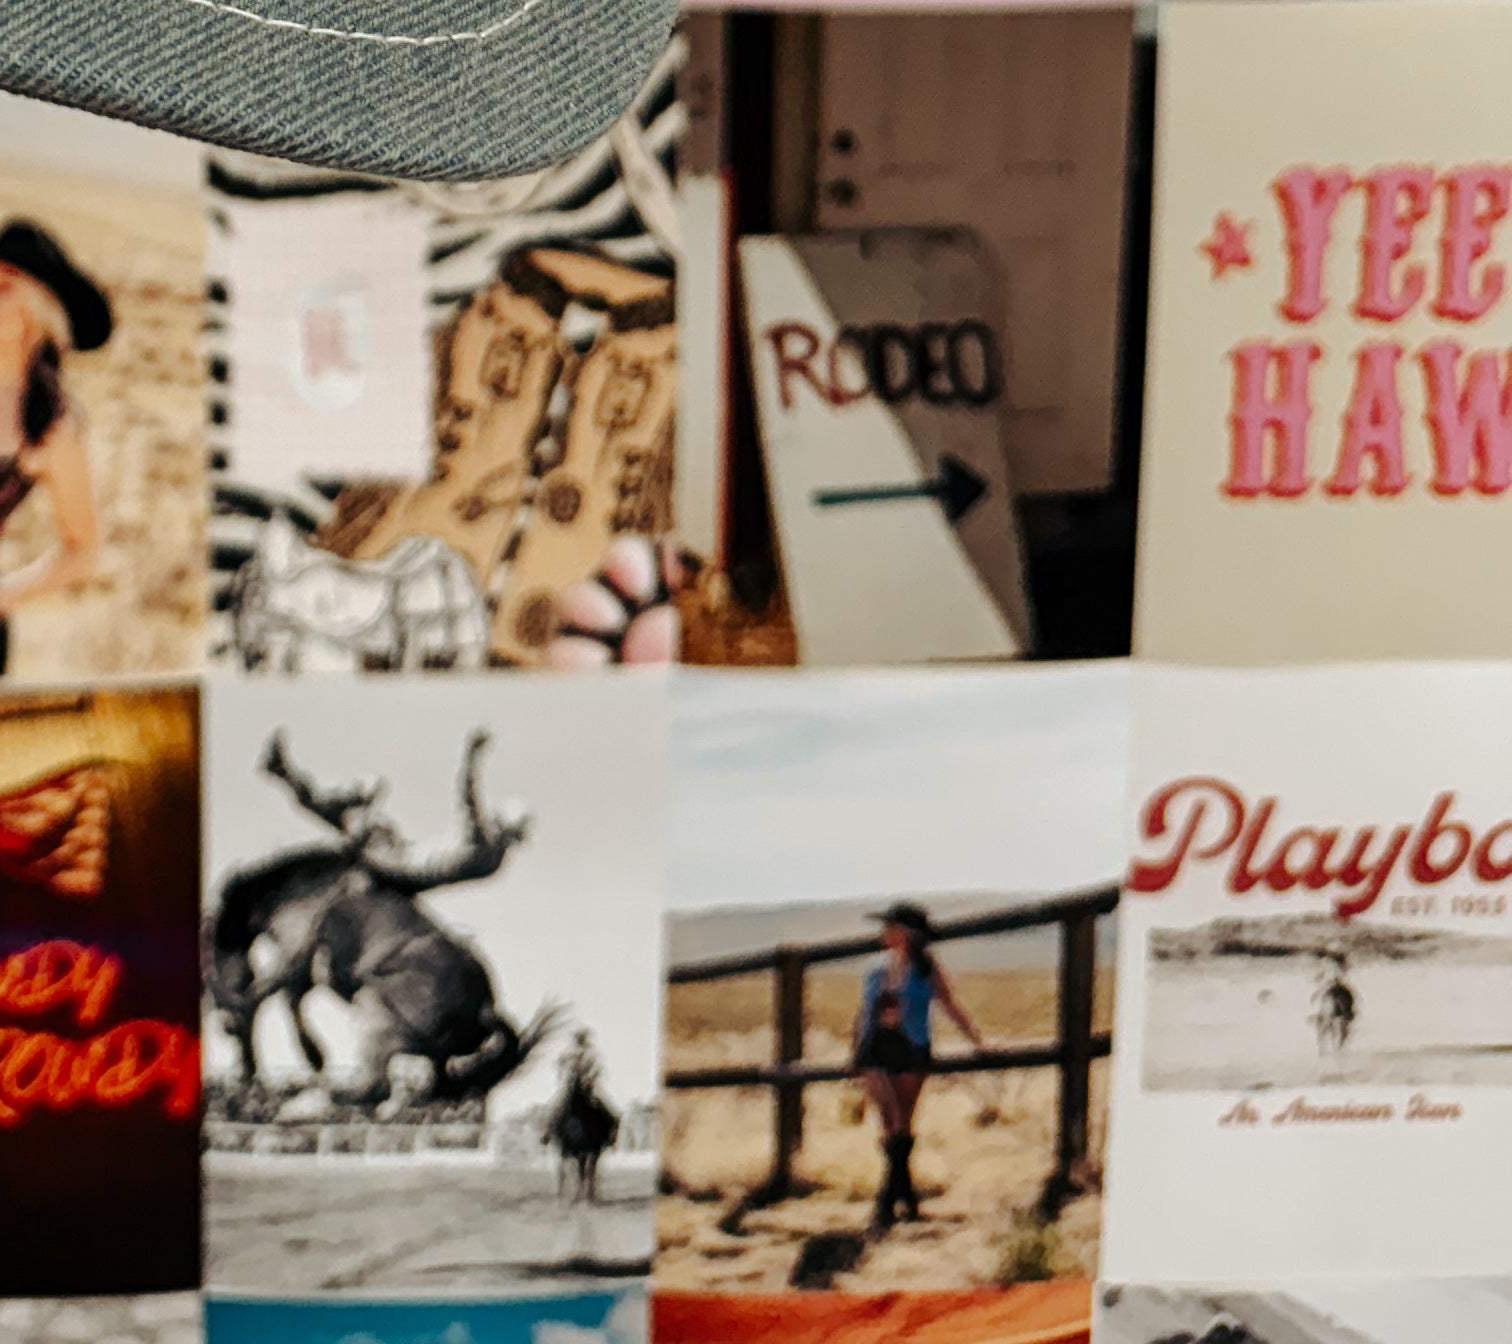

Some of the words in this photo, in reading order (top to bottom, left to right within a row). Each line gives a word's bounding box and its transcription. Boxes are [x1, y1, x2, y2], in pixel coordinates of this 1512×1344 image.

[1271, 164, 1512, 323] YEE
[766, 319, 1002, 410] RODEO
[1221, 340, 1512, 499] HAW
